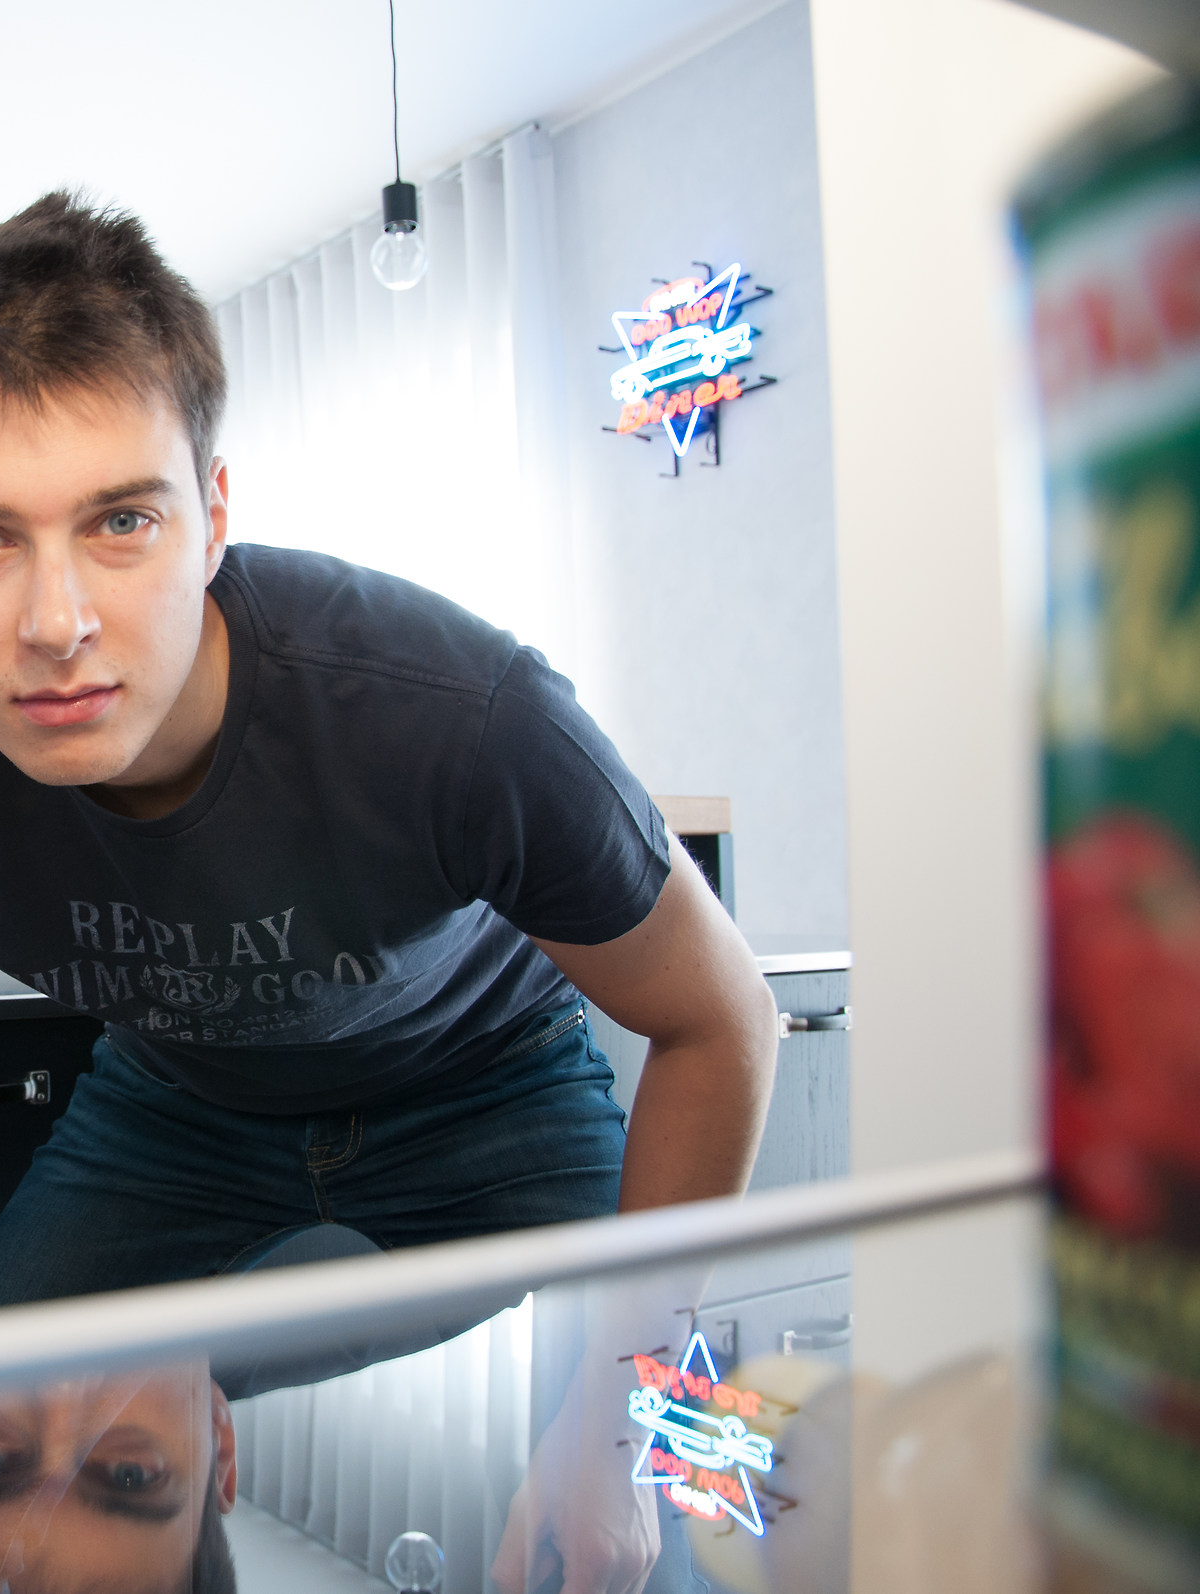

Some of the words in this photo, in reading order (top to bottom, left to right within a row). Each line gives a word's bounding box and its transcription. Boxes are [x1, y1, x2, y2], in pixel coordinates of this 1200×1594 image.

[68, 900, 296, 967] REPLAY
[28, 959, 135, 1011] NIM
[252, 951, 386, 1005] GOO
